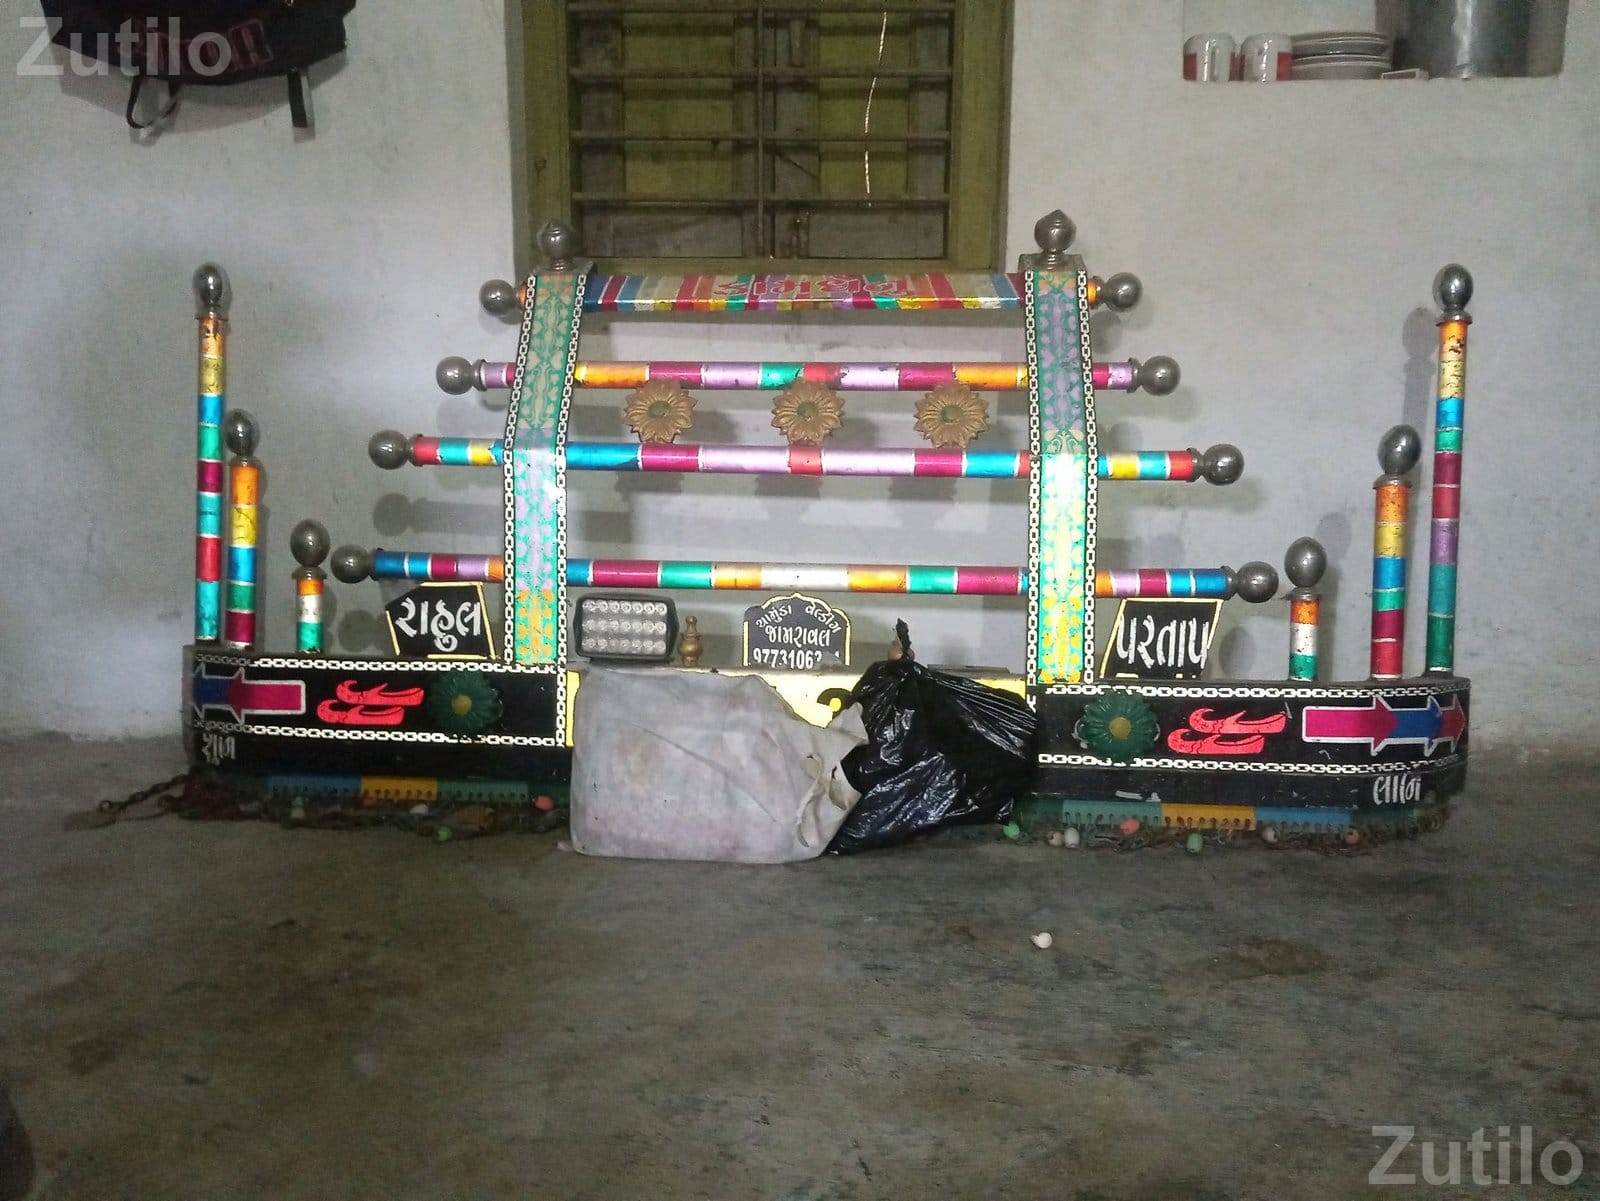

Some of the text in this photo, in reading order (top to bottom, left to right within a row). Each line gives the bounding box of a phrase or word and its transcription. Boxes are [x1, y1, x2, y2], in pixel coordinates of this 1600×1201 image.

[395, 597, 481, 652] રાહુલ
[765, 625, 831, 648] જામરાવલ
[1116, 614, 1209, 669] પરતાપ
[1373, 771, 1421, 805] લાભ
